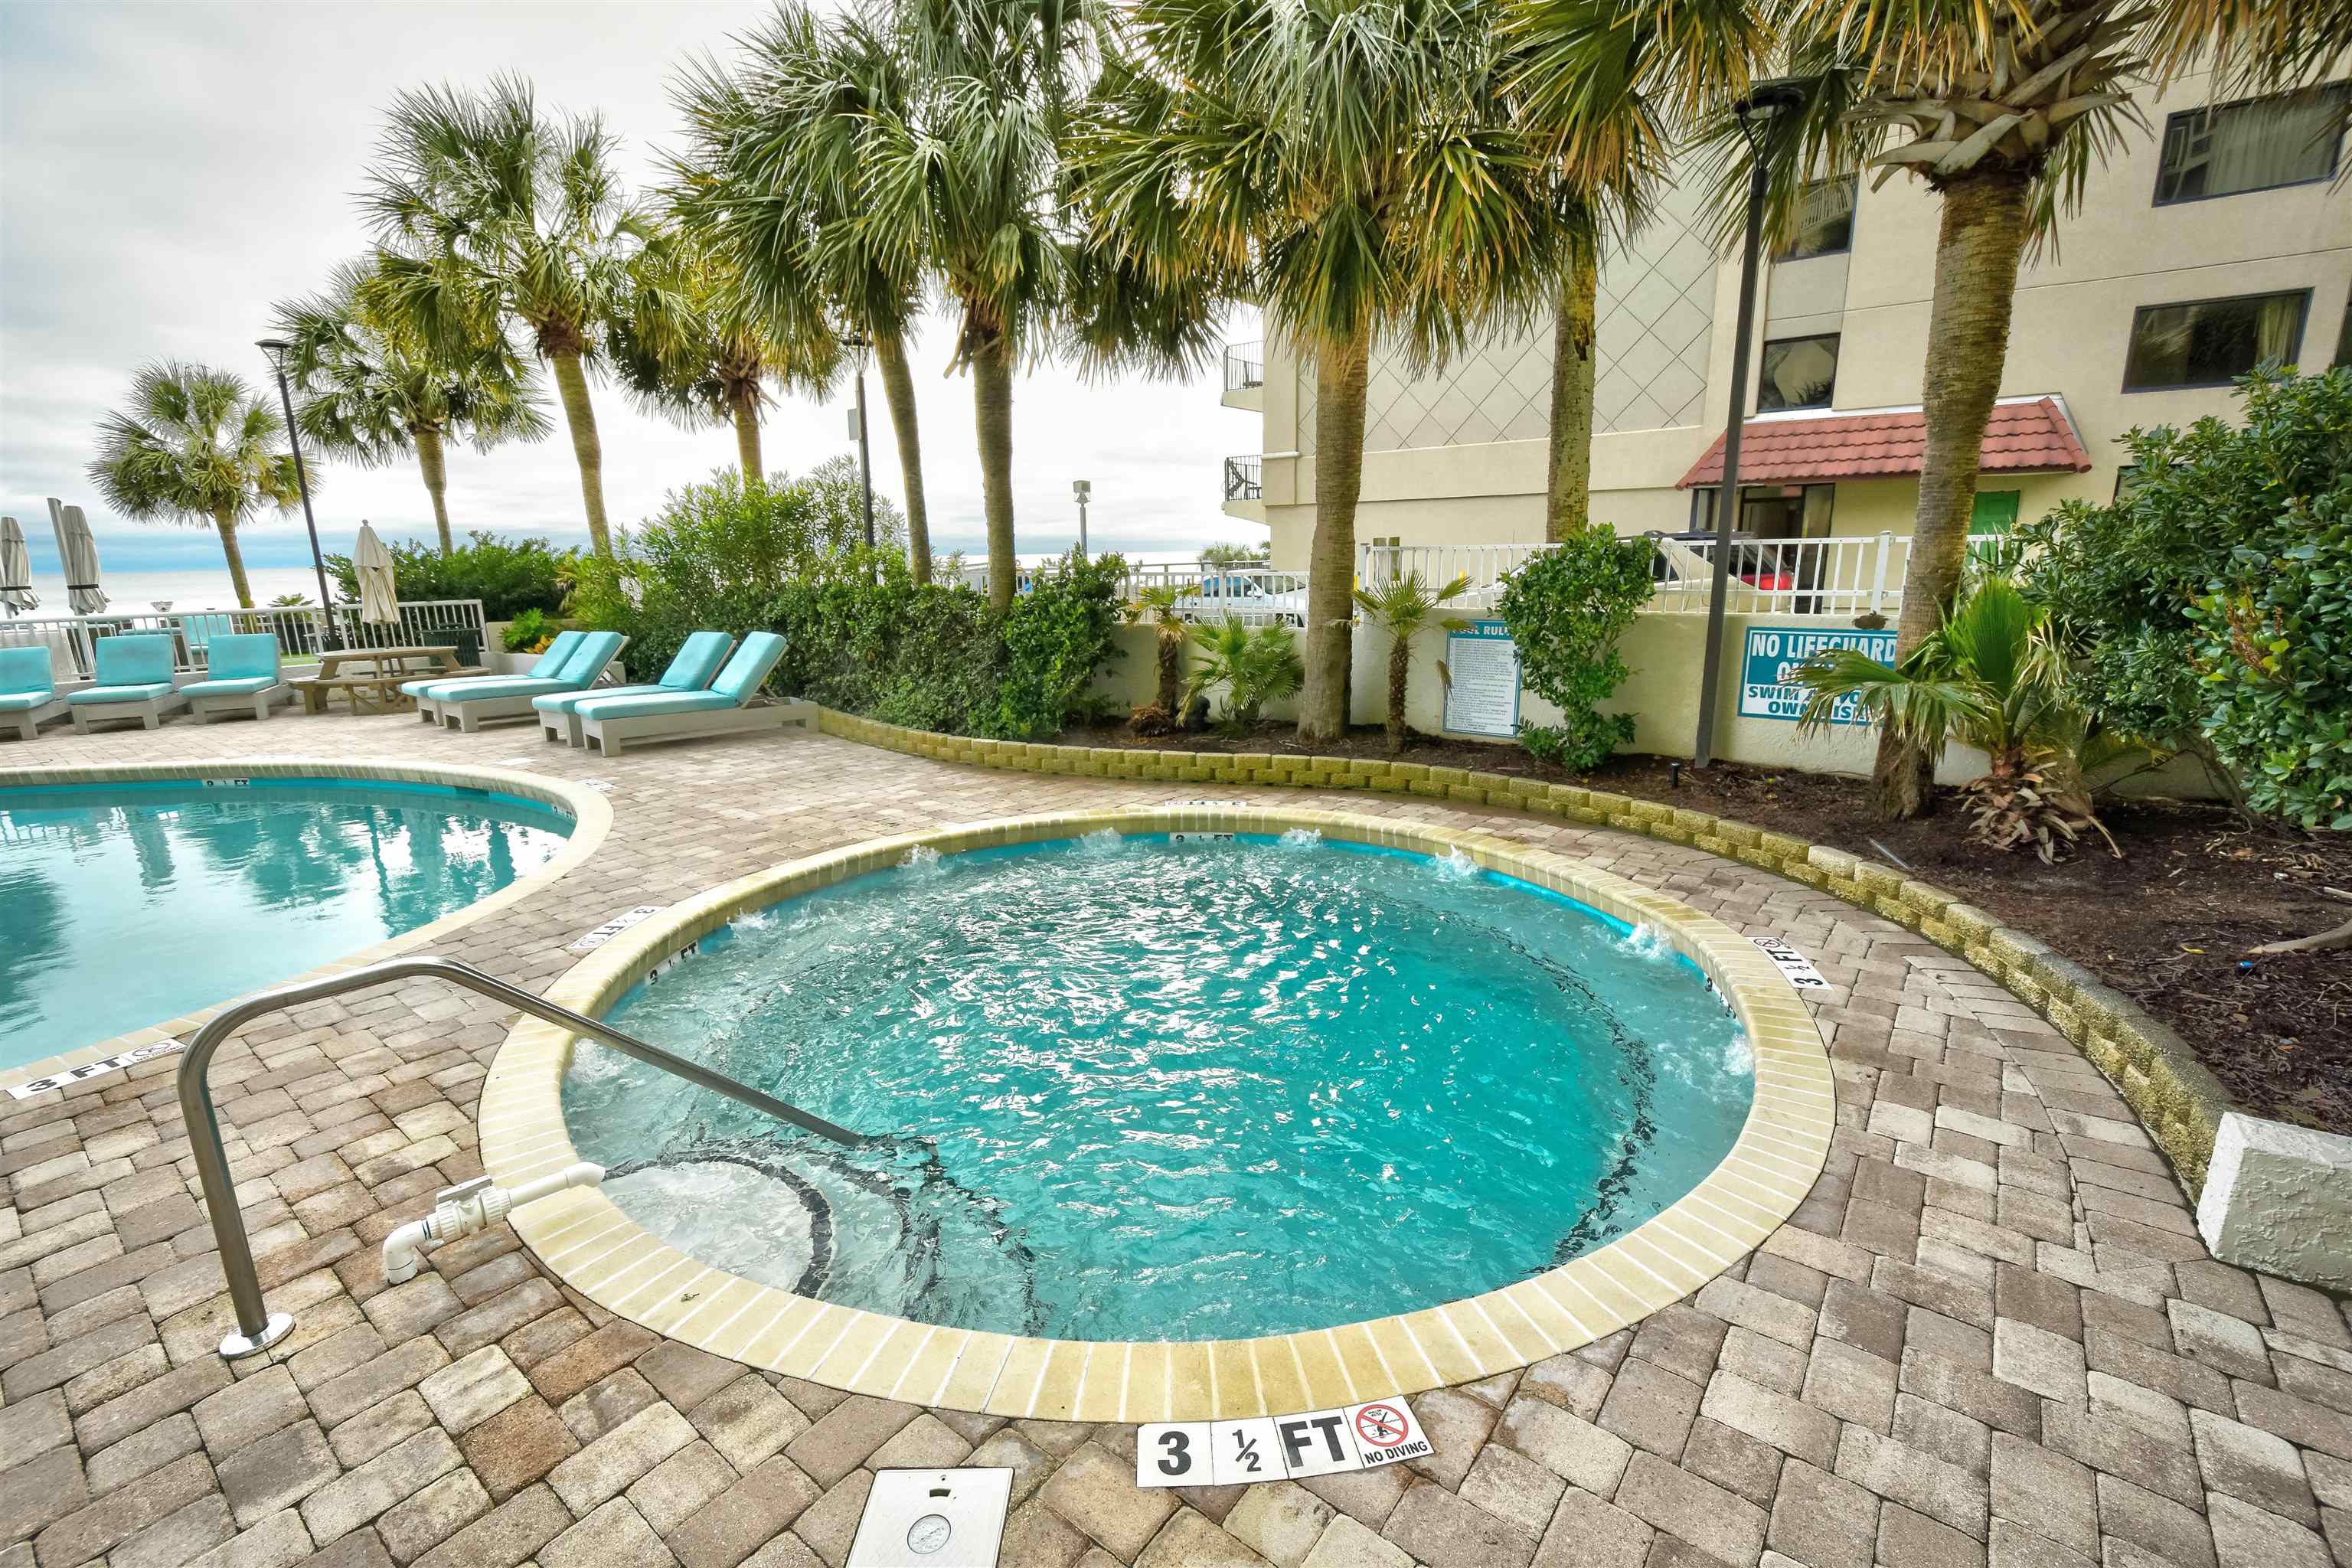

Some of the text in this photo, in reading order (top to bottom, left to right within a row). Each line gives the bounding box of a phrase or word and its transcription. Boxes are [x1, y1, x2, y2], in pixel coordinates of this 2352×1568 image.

[1752, 634, 1780, 657] NO
[1748, 685, 1799, 700] SWIM
[1765, 949, 1803, 962] FT
[1793, 977, 1824, 986] 3
[26, 1056, 119, 1093] 3 FT
[1157, 1430, 1192, 1476] 3
[1279, 1416, 1346, 1468] FT
[1364, 1441, 1428, 1464] NO DIVING
